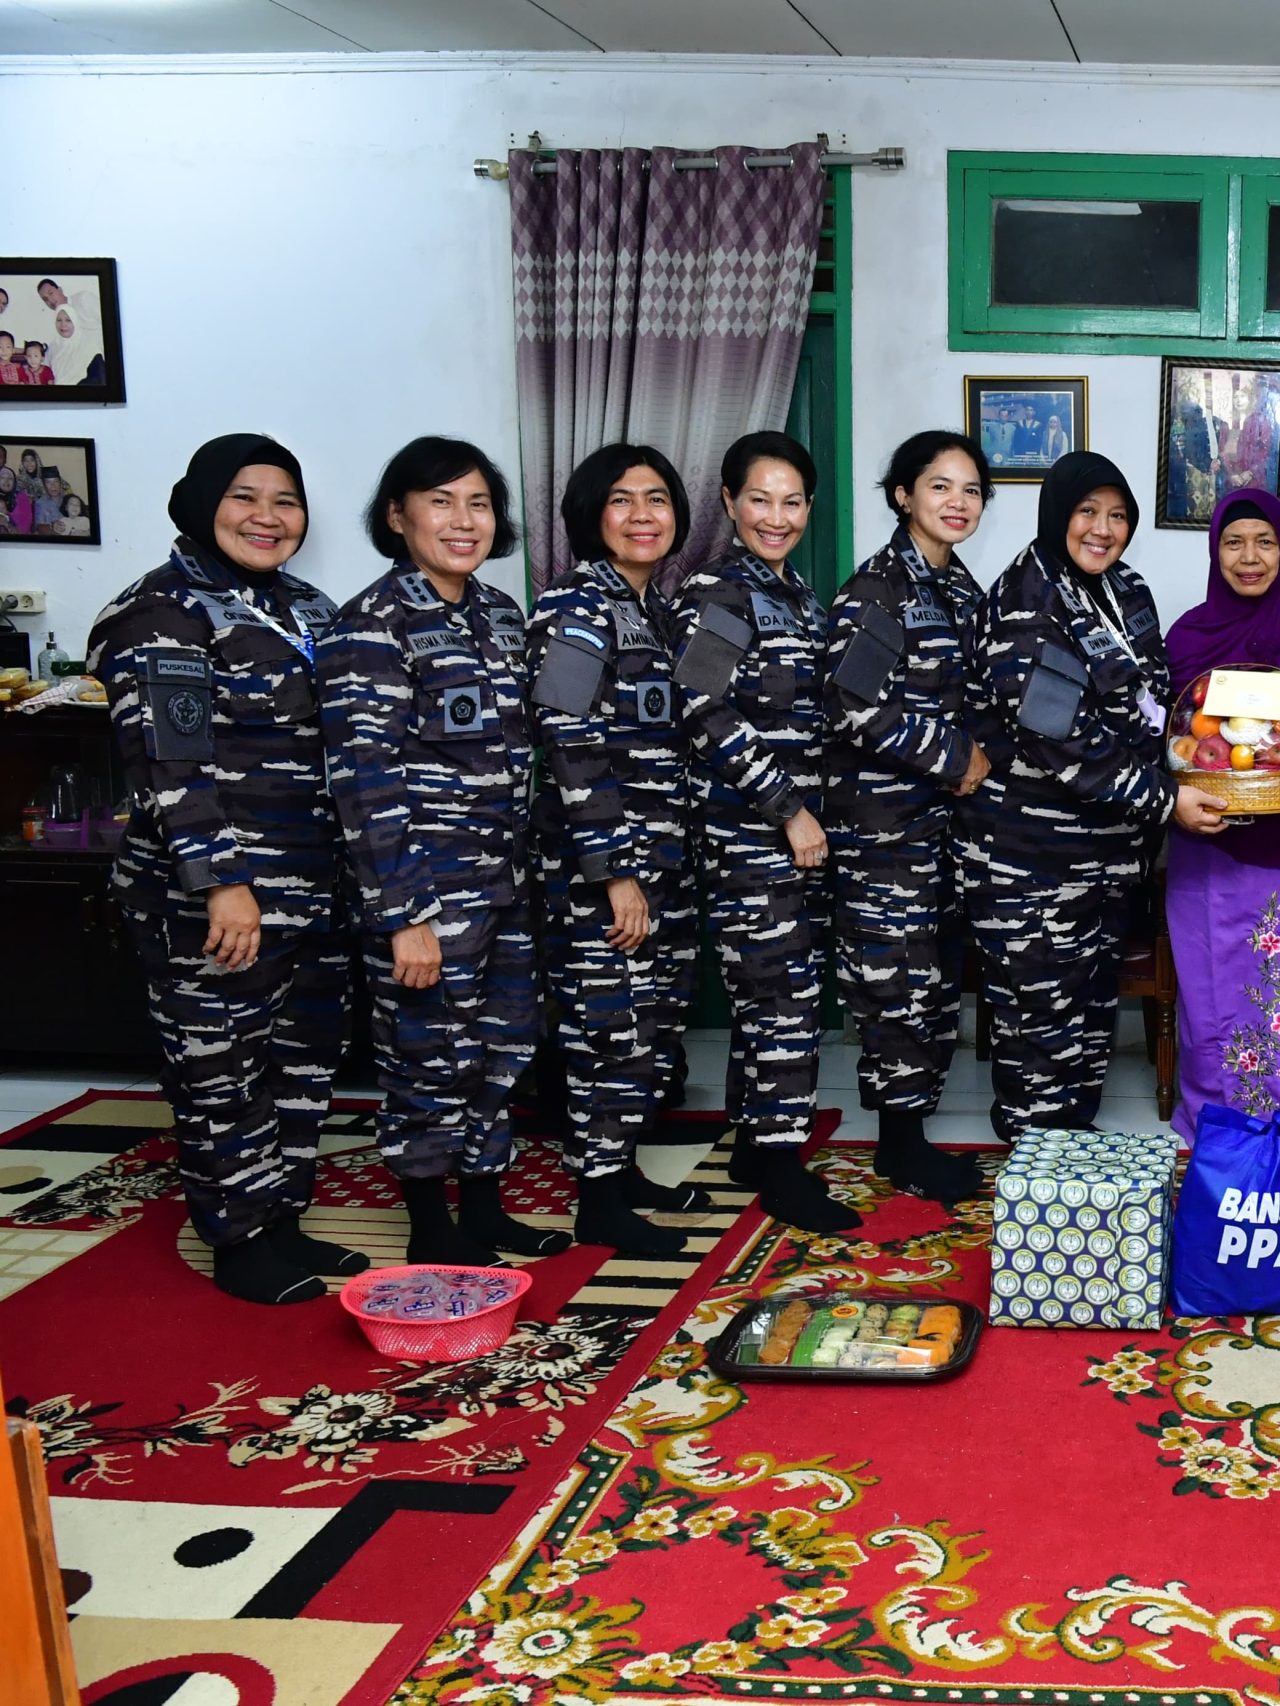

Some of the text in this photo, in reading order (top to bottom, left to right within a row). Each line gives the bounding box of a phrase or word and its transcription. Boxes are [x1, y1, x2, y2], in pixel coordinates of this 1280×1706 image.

[300, 608, 325, 620] TNI
[758, 615, 781, 627] IDA
[412, 634, 441, 651] RISMA
[498, 634, 521, 647] TNI
[159, 663, 204, 674] PUSKESAL
